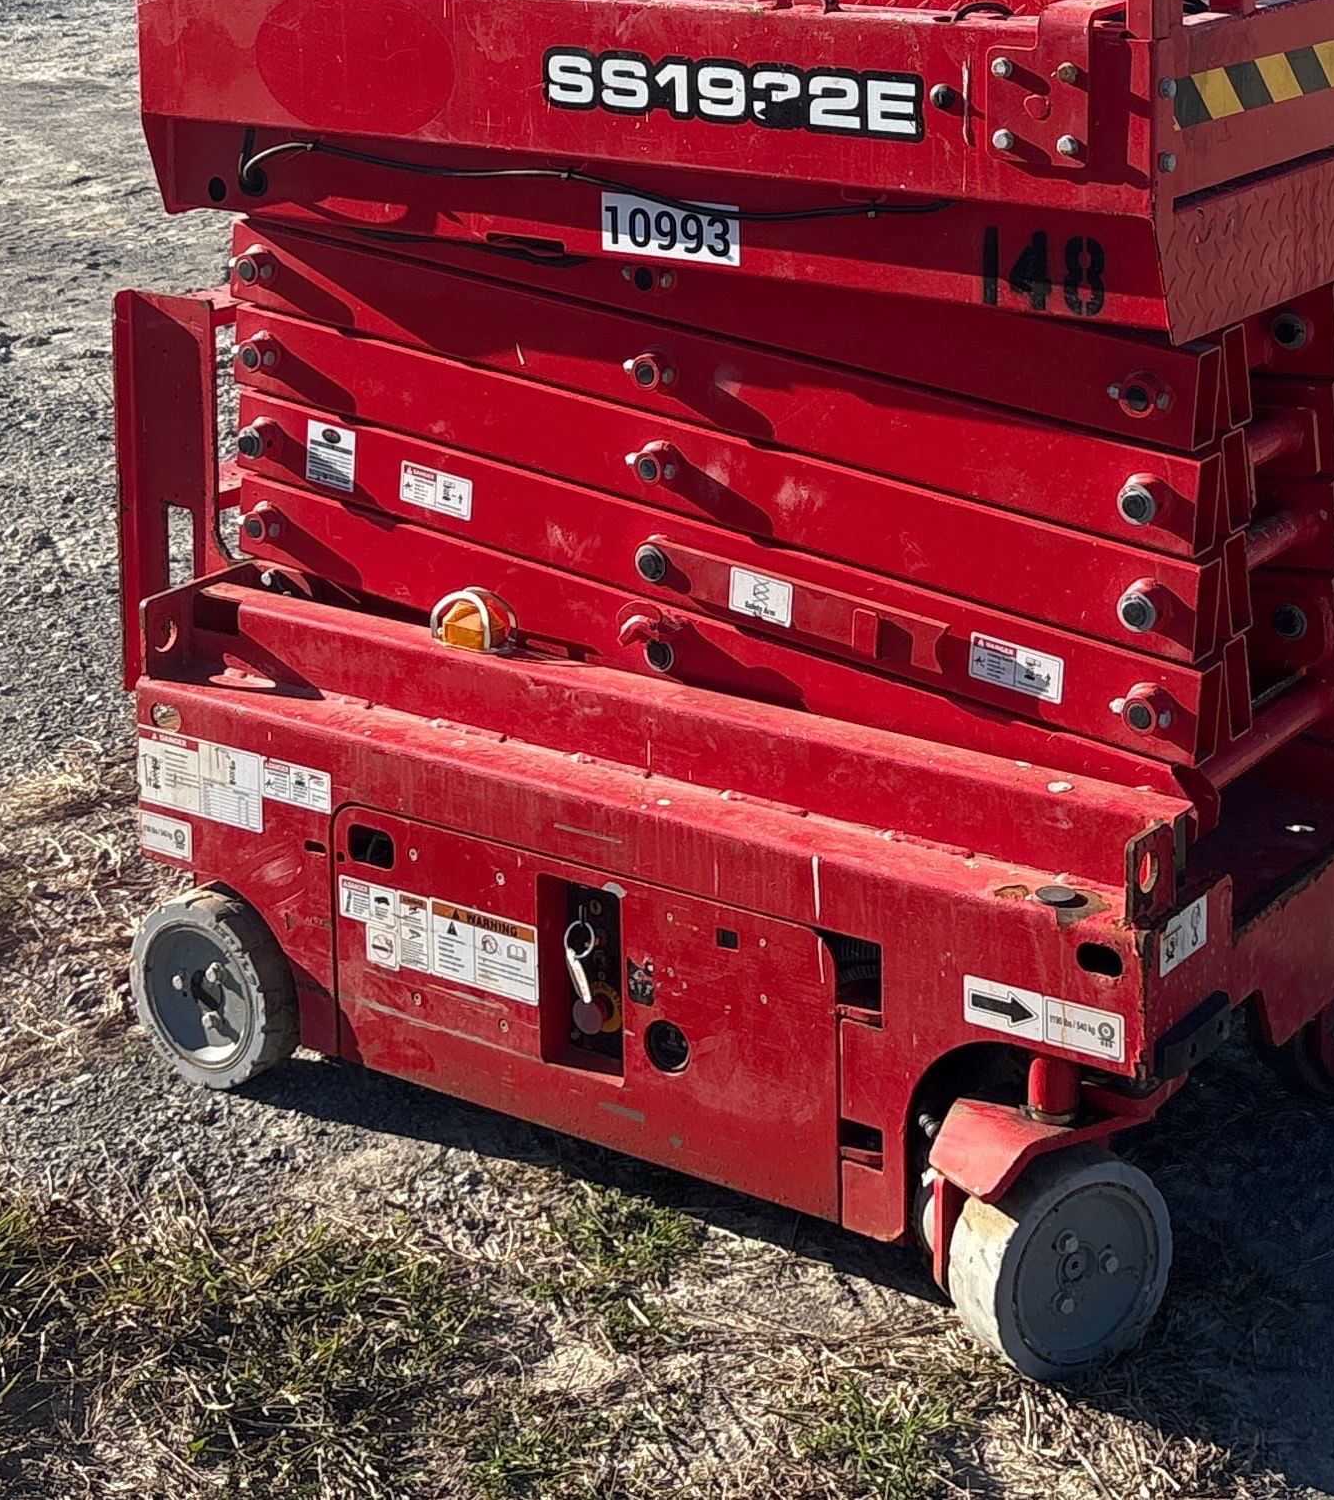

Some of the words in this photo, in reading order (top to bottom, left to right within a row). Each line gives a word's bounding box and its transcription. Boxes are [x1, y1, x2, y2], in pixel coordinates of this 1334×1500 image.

[603, 203, 732, 258] 10993
[982, 224, 1106, 317] 148
[466, 913, 518, 937] WARNING
